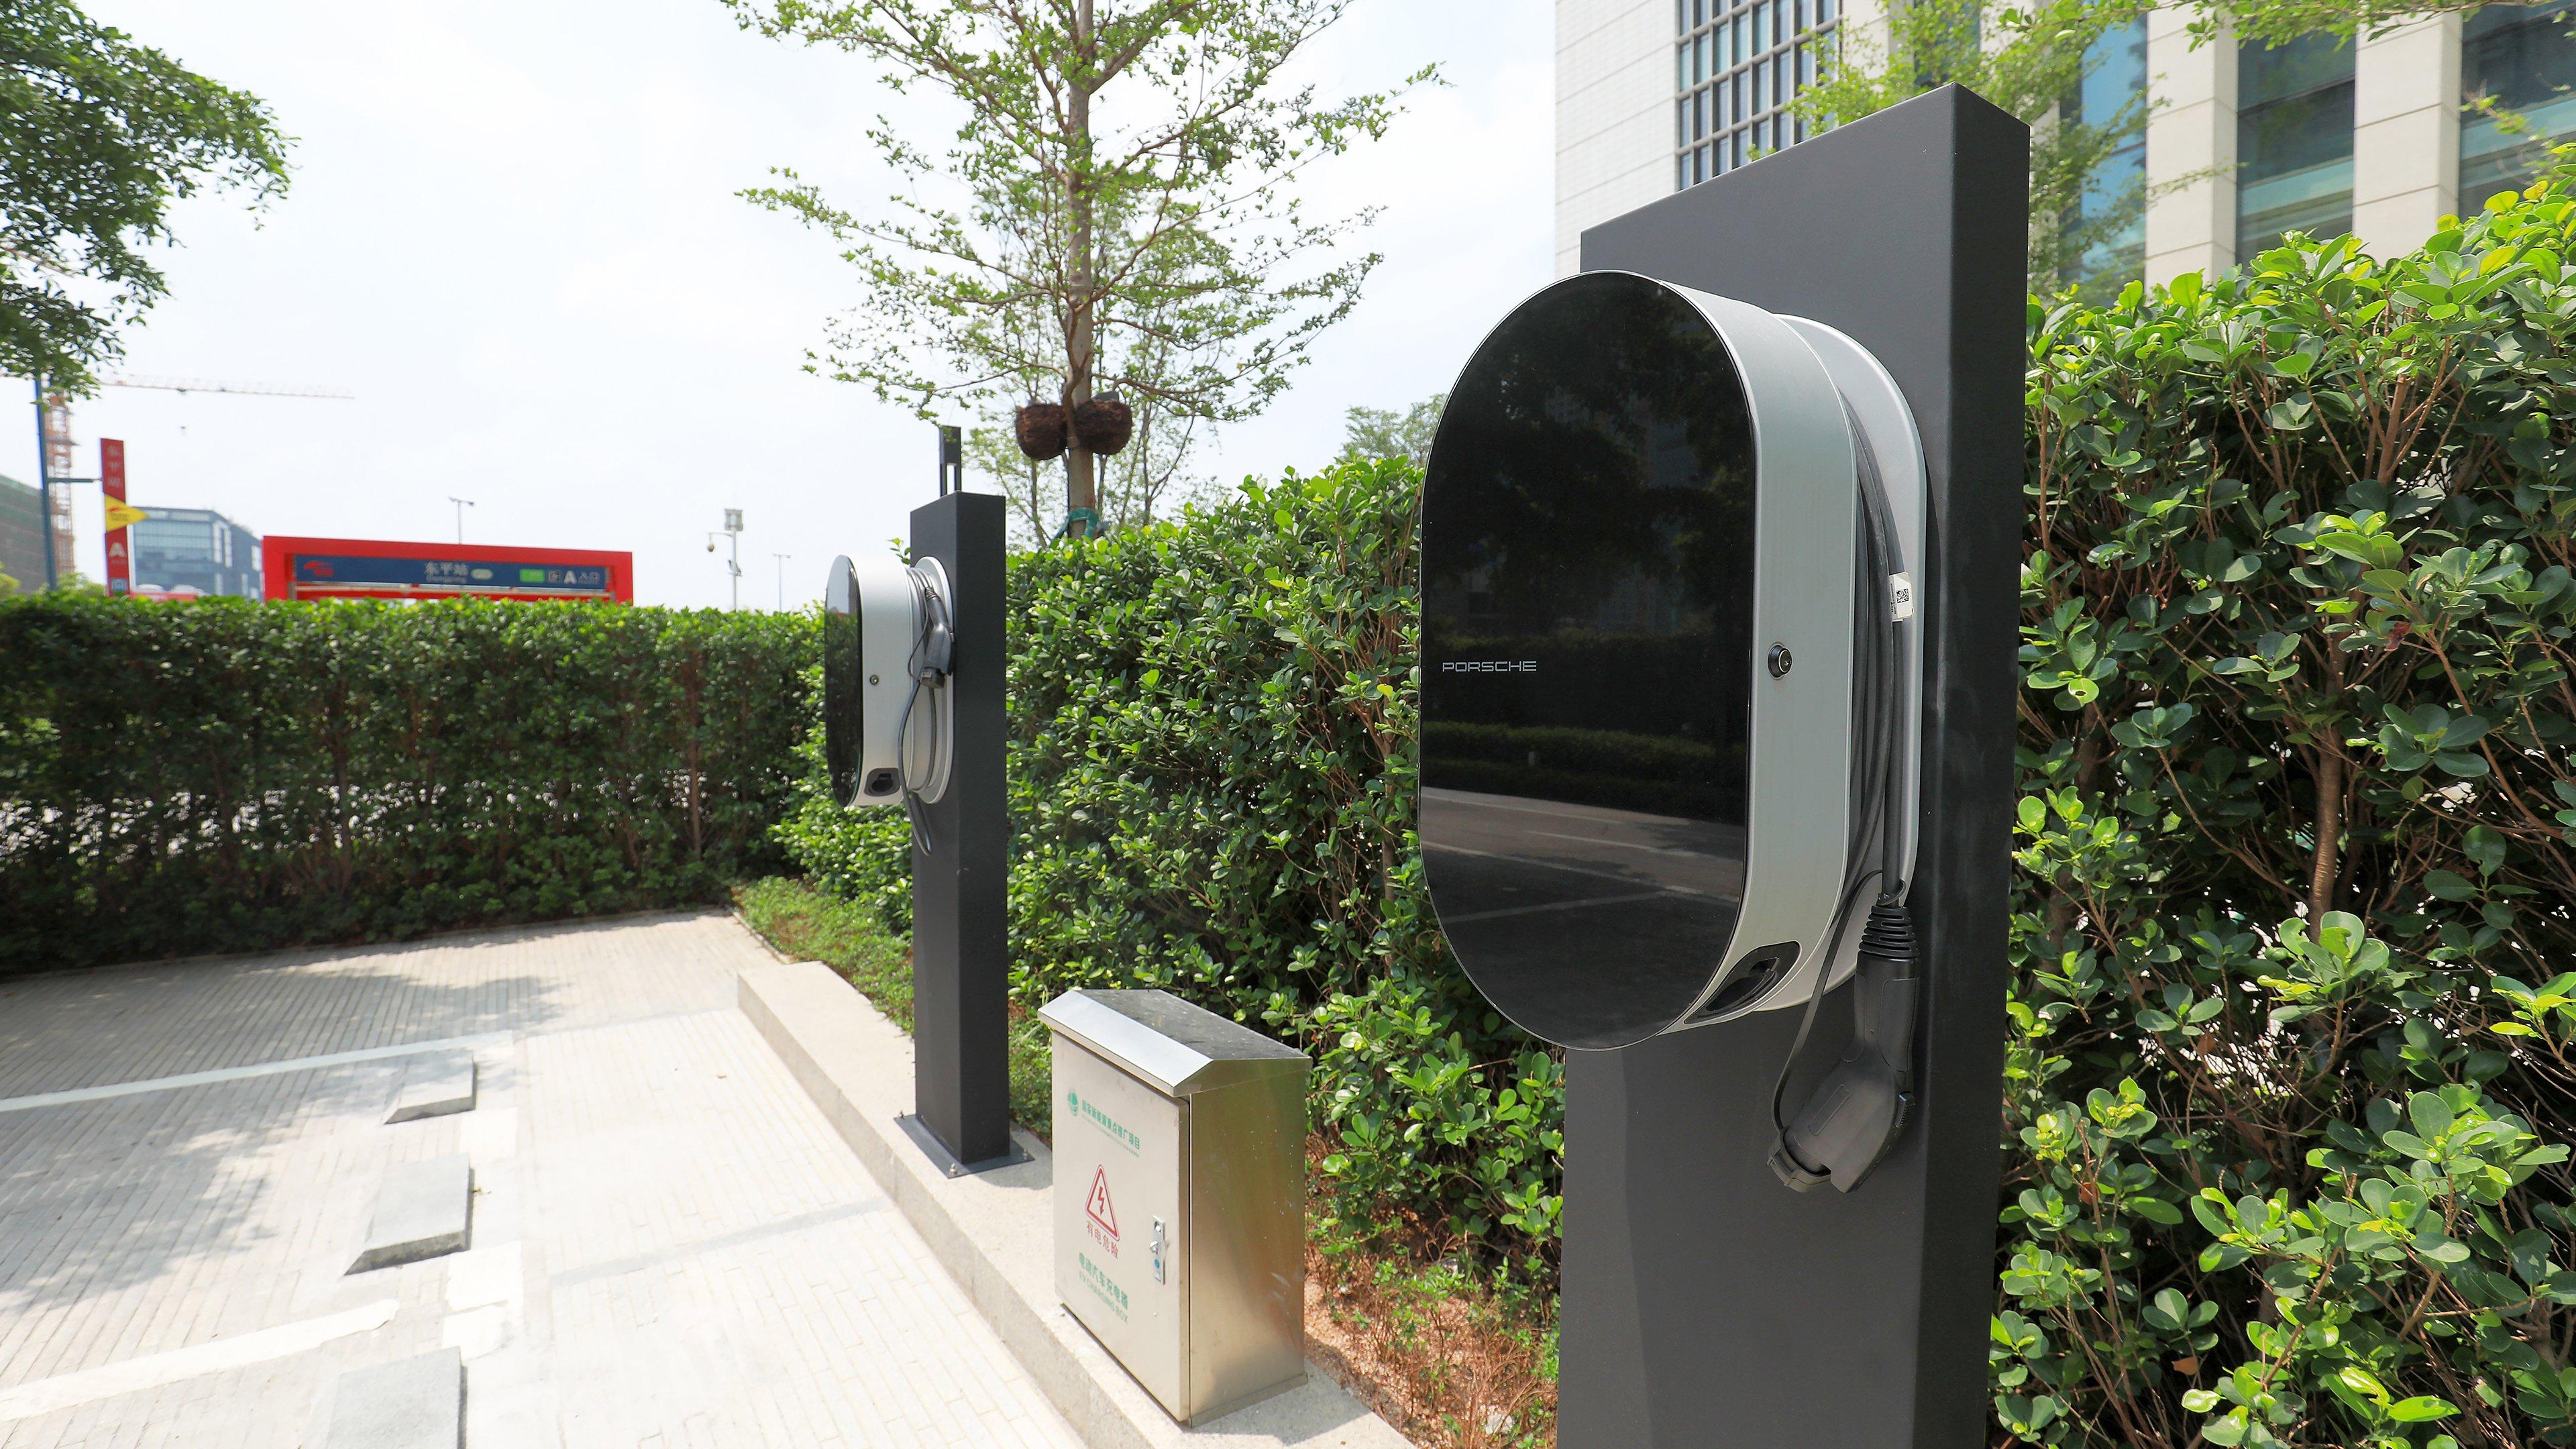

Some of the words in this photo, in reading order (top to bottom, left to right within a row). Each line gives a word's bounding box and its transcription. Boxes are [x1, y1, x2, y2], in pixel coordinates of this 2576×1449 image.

[109, 542, 126, 557] A
[424, 561, 468, 576] 东平站
[564, 570, 577, 584] A
[1442, 661, 1537, 672] PORSCHE
[1087, 1220, 1118, 1260] 有电危险
